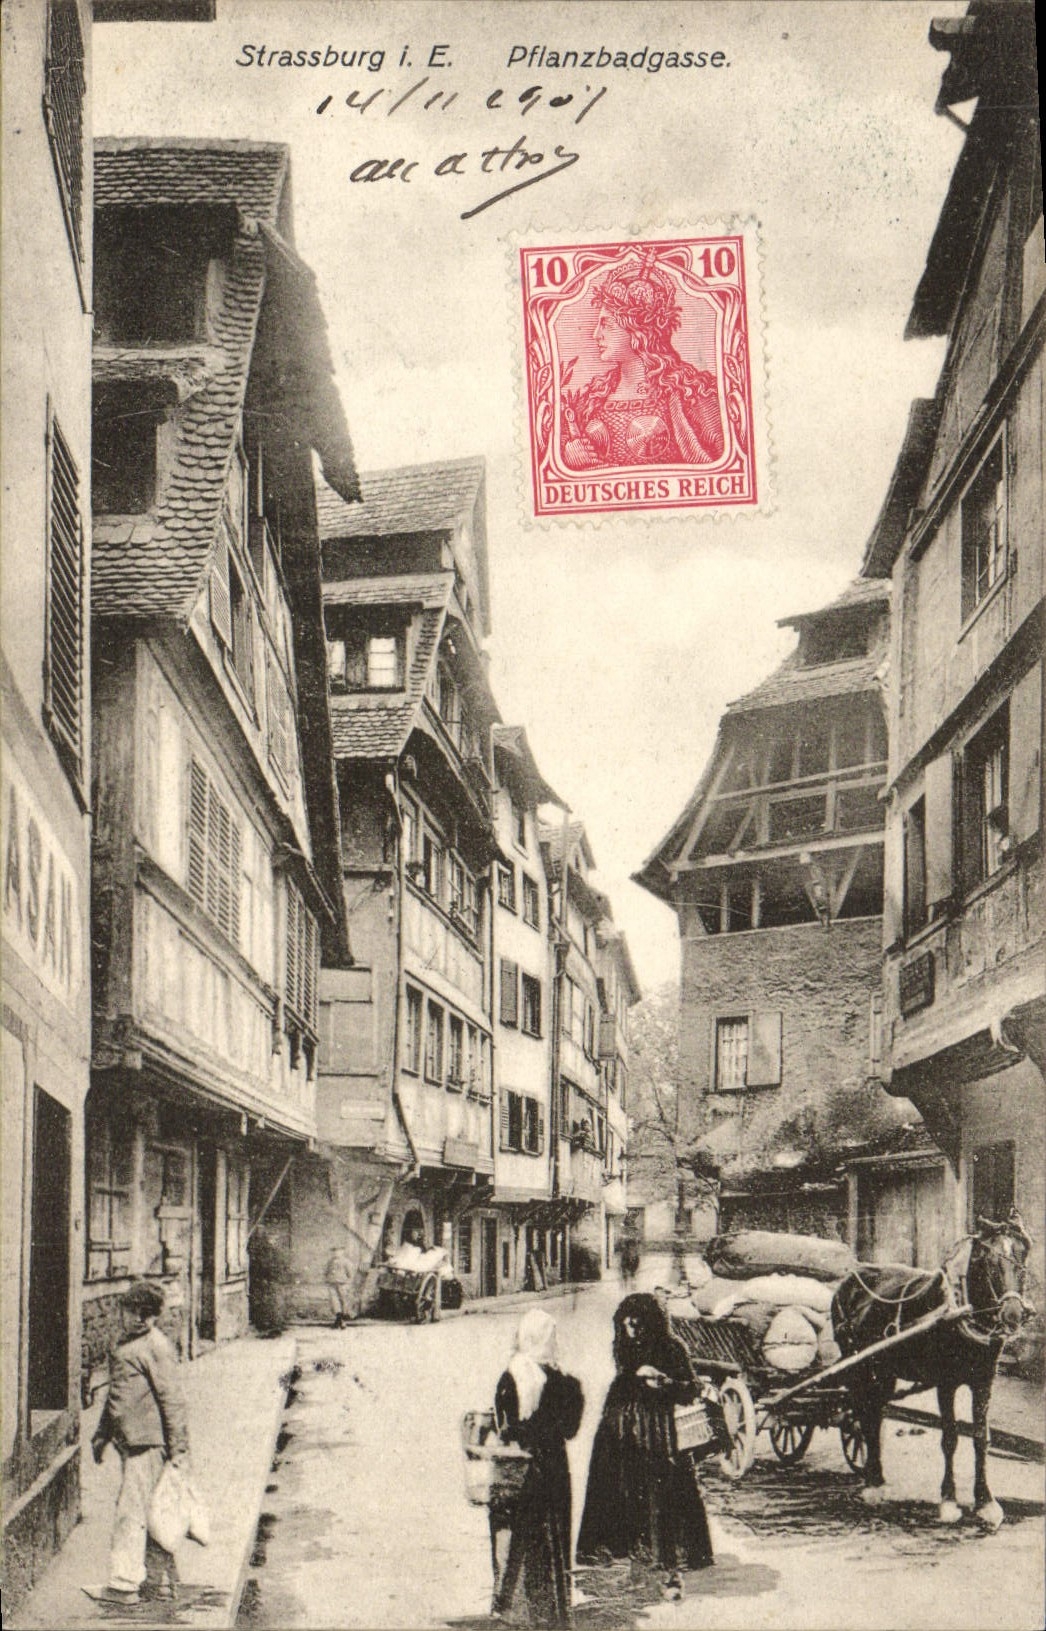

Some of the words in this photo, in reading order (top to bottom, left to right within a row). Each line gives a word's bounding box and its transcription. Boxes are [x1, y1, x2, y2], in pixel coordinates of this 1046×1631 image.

[531, 256, 569, 288] 10
[699, 246, 736, 279] 10
[545, 479, 670, 505] DEUTSCHES
[678, 475, 745, 498] REICH
